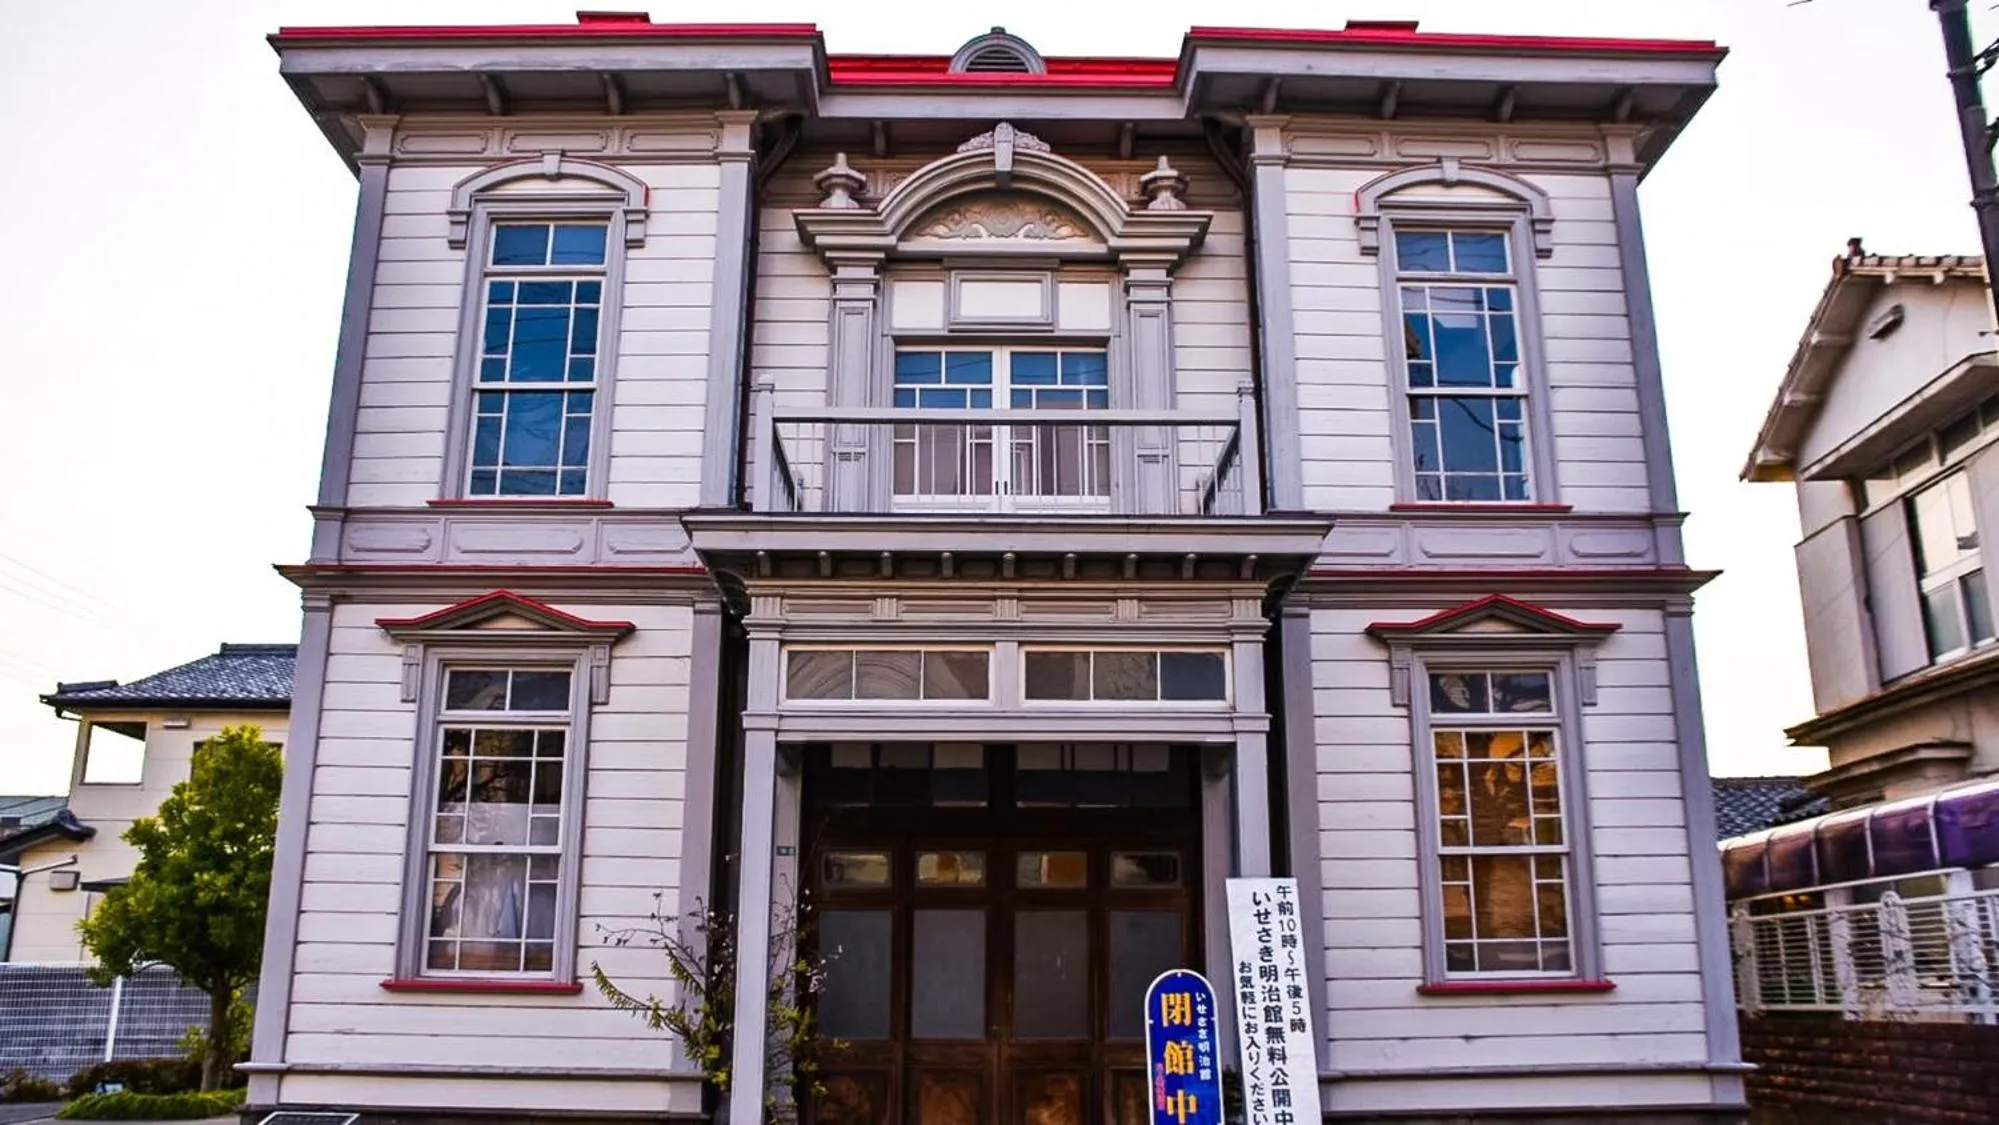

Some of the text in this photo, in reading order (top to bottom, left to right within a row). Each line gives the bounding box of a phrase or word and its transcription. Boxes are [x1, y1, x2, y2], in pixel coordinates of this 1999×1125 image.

[1160, 992, 1197, 1124] 閉館中
[1238, 961, 1268, 1125] お気軽にお入りください
[1253, 892, 1294, 1125] いせさき明治館無料公開中
